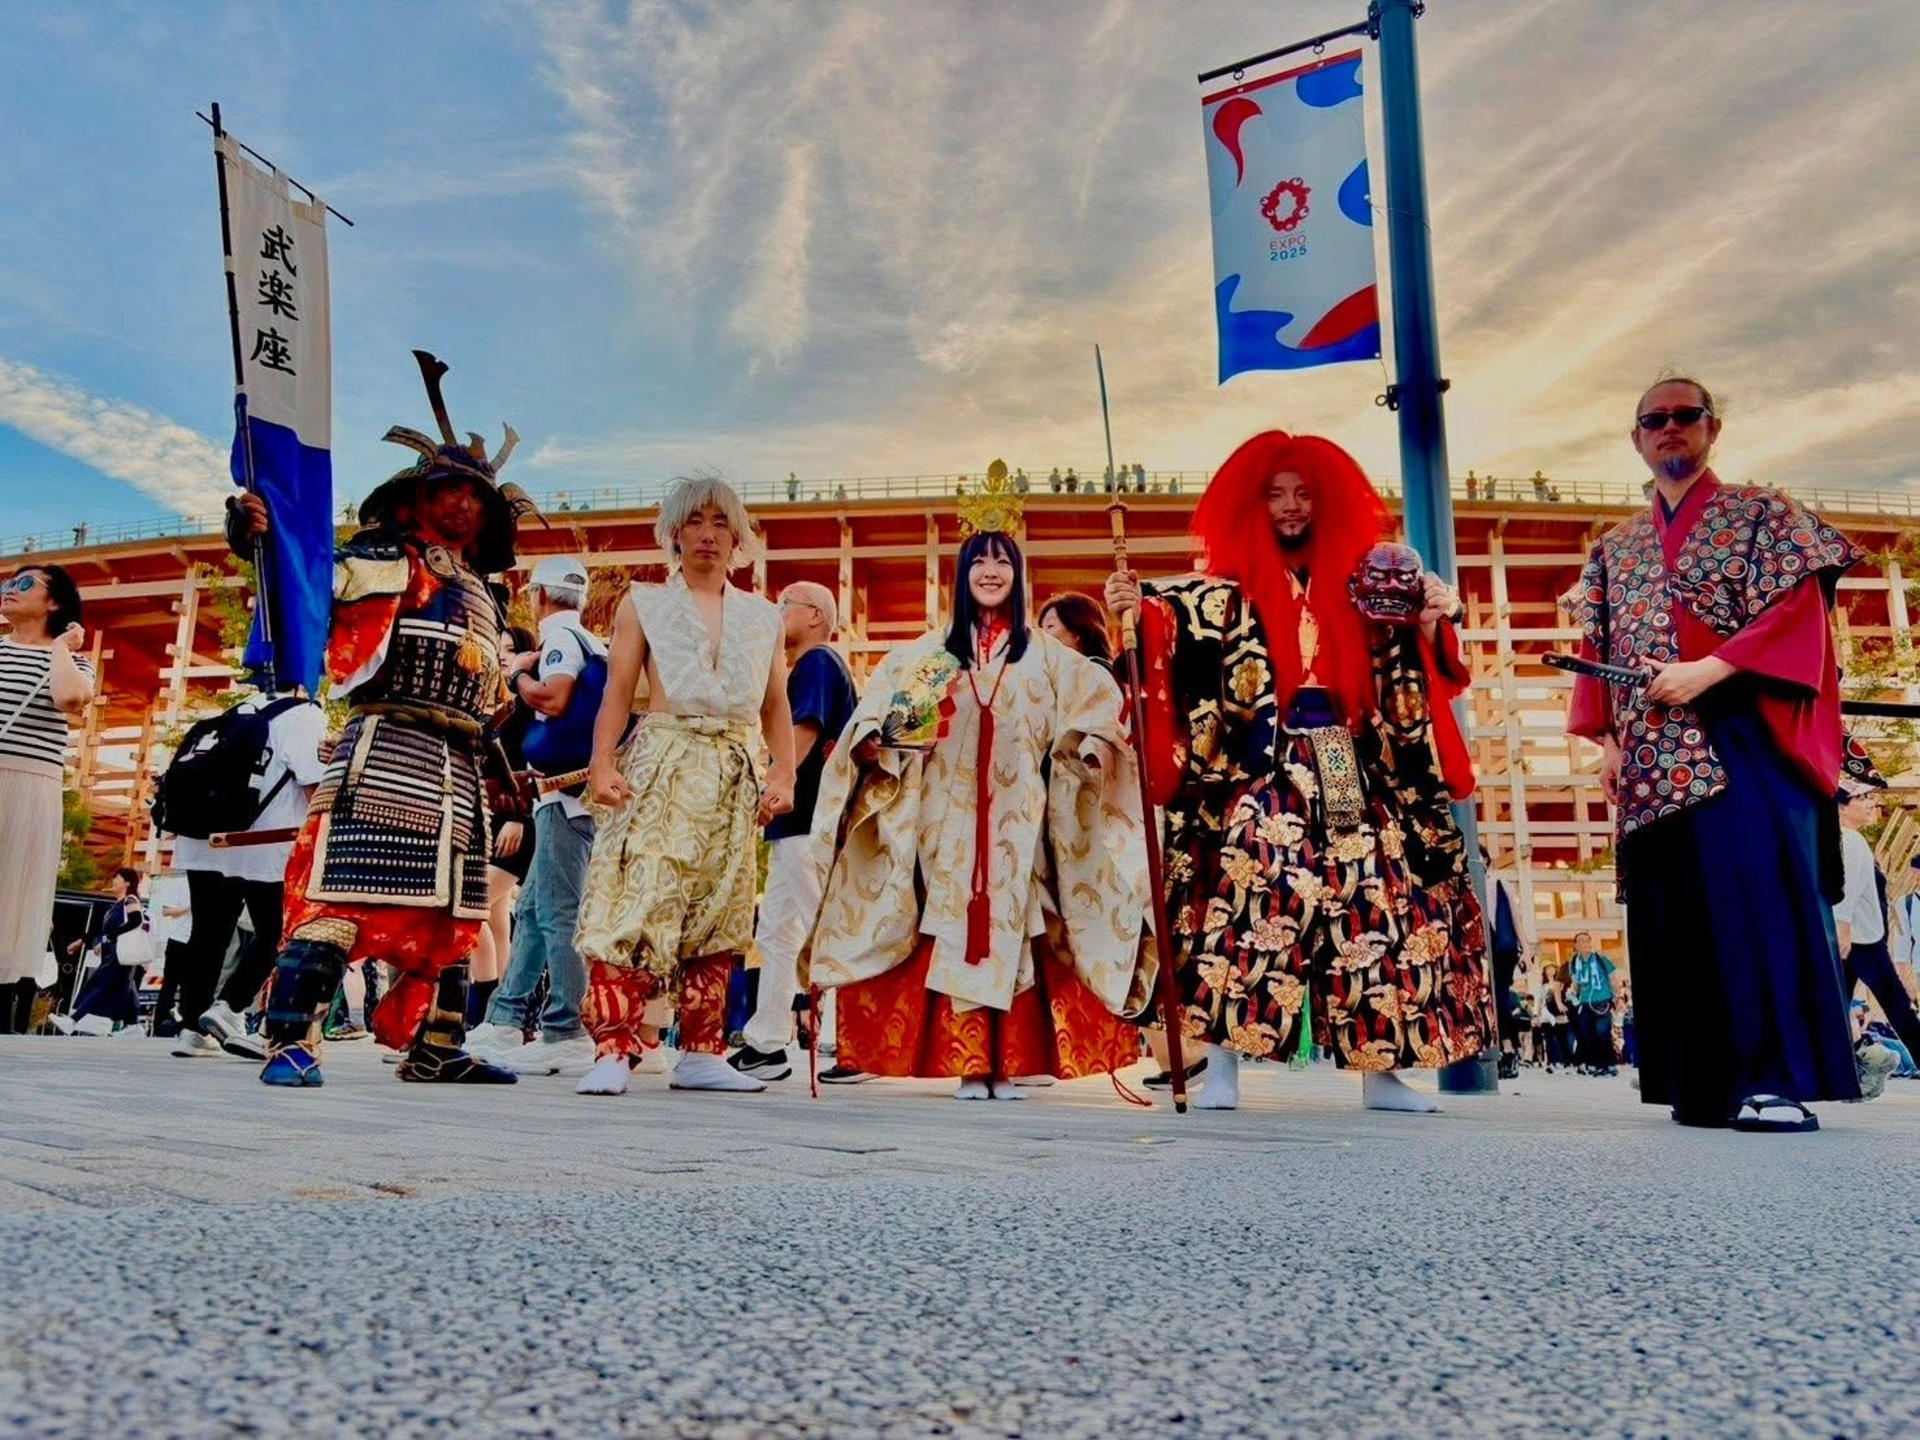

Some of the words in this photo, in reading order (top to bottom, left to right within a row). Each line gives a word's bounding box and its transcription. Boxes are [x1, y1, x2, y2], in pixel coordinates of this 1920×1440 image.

[1269, 234, 1306, 250] EXPO
[1270, 245, 1307, 261] 2025
[250, 224, 300, 377] 武楽座
